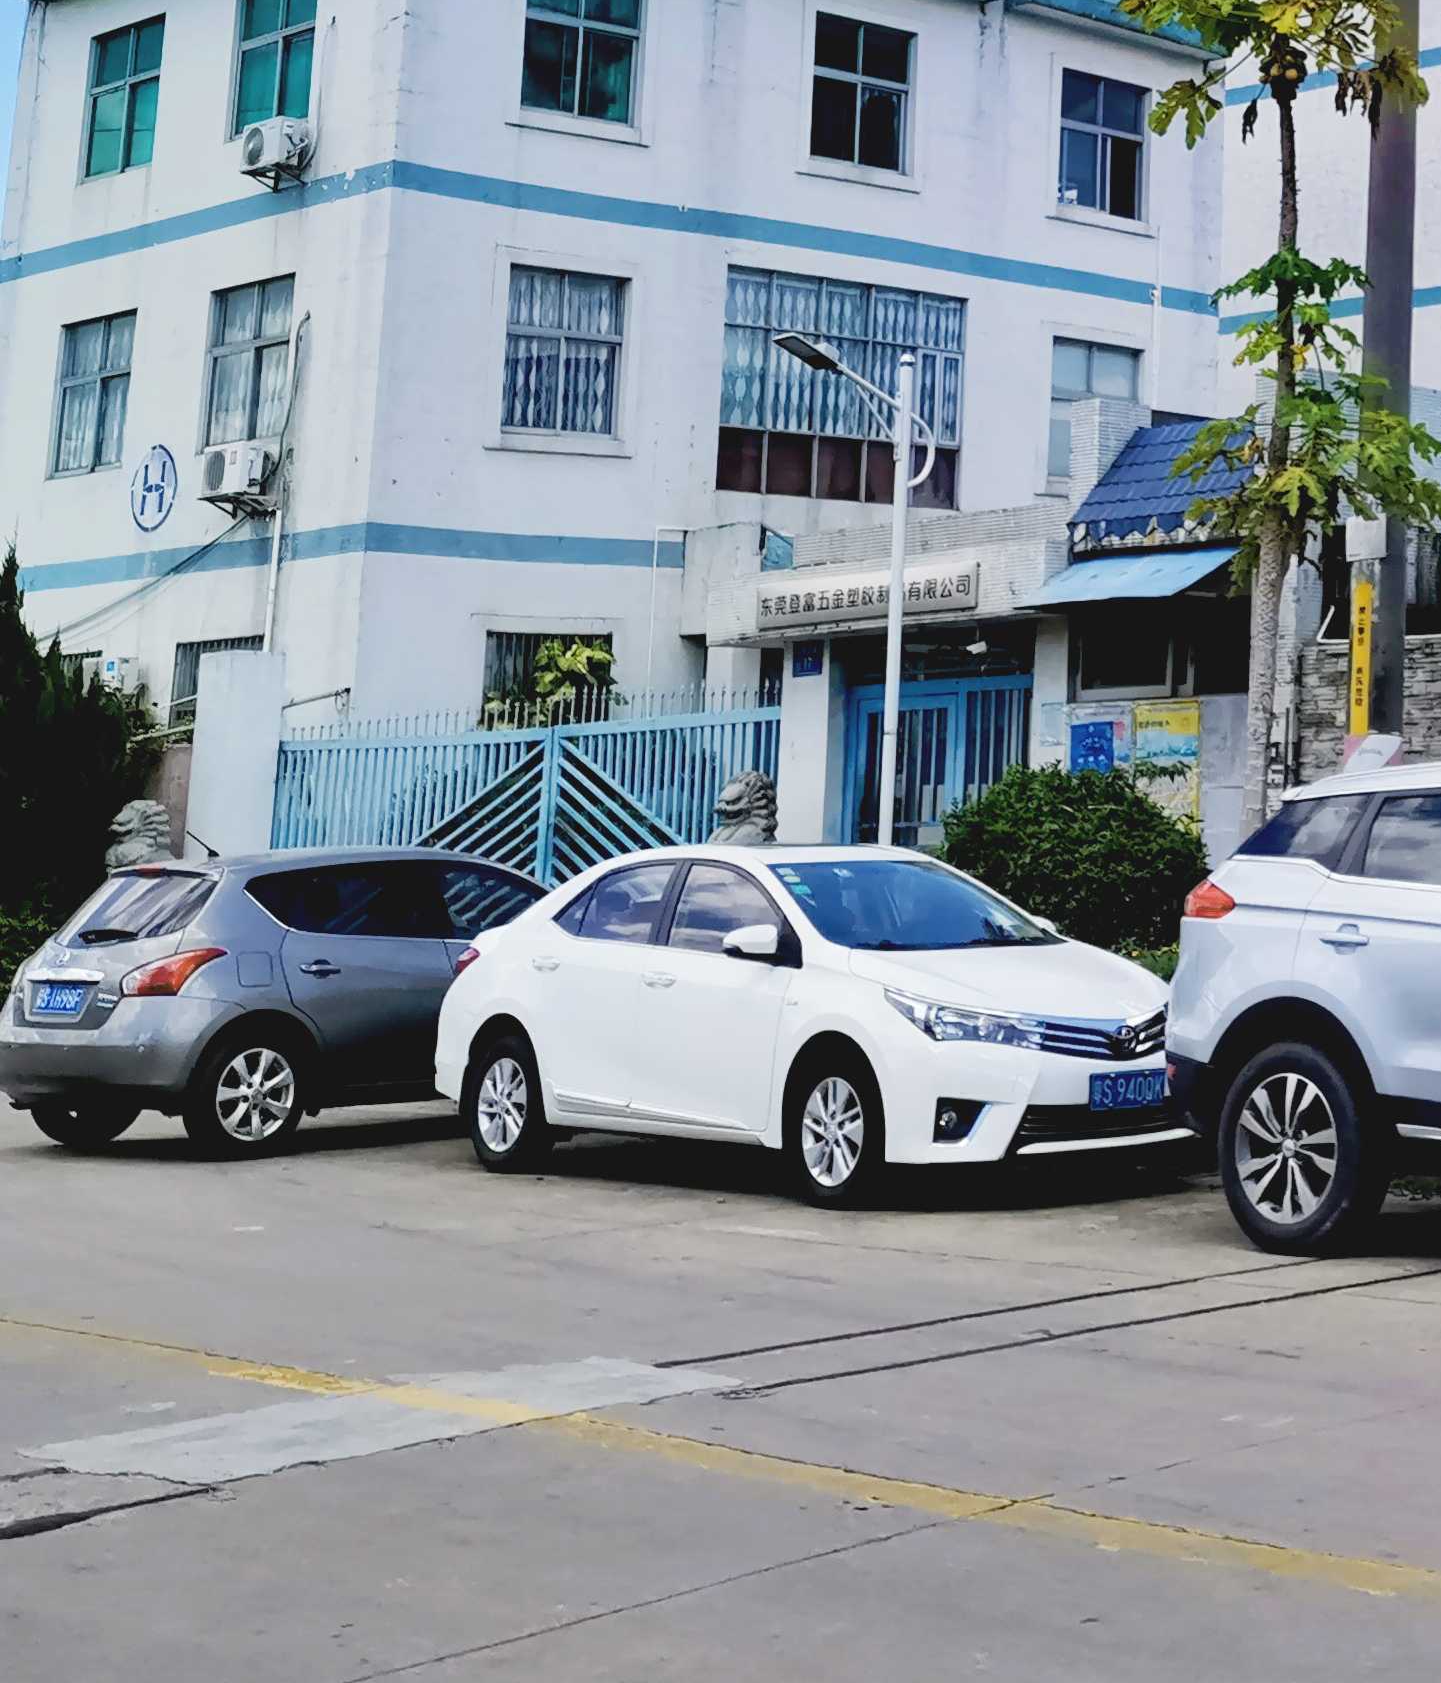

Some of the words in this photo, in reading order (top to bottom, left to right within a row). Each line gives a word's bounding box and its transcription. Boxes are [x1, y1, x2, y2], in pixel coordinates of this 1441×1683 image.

[760, 574, 971, 617] 东莞登富五金塑胶制有限公司
